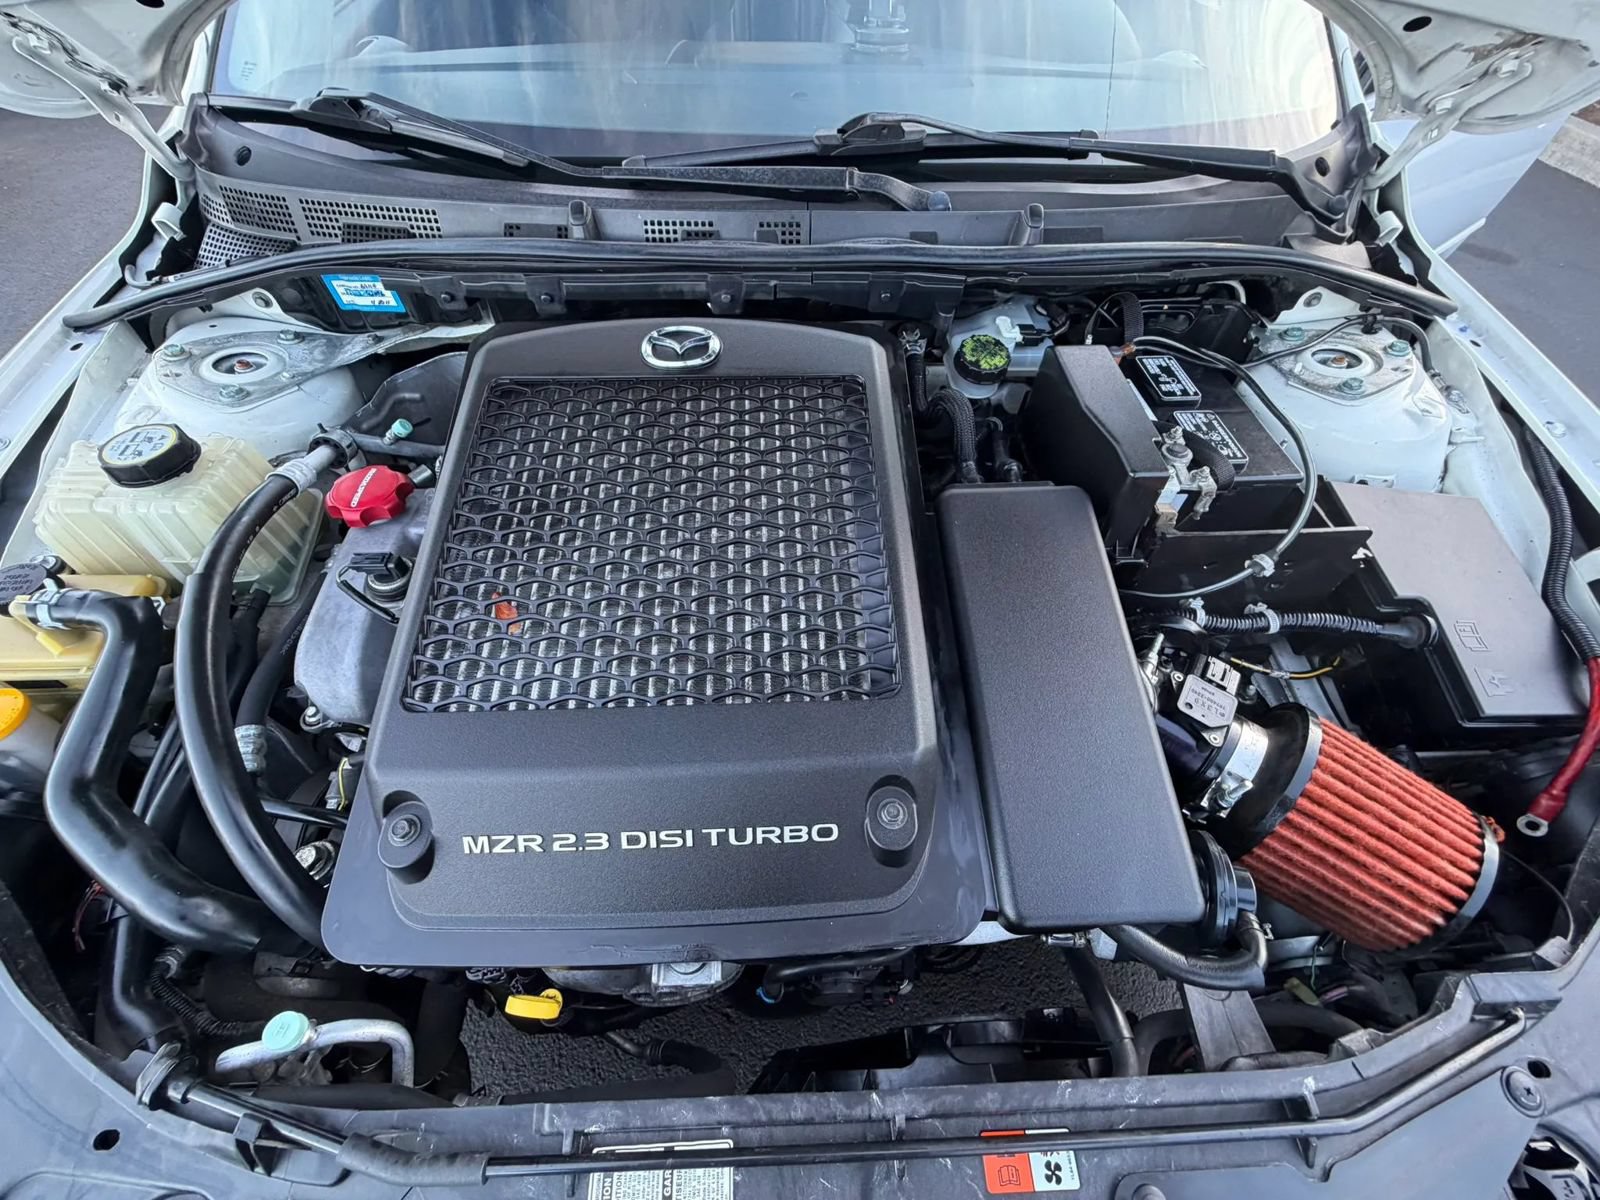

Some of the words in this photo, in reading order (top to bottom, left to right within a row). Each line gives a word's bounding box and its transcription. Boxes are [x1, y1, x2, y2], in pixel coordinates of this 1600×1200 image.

[462, 834, 544, 855] MZR
[552, 832, 610, 852] 2.3
[620, 829, 694, 849] DISI
[702, 823, 840, 846] TURBO
[603, 1178, 612, 1200] ION
